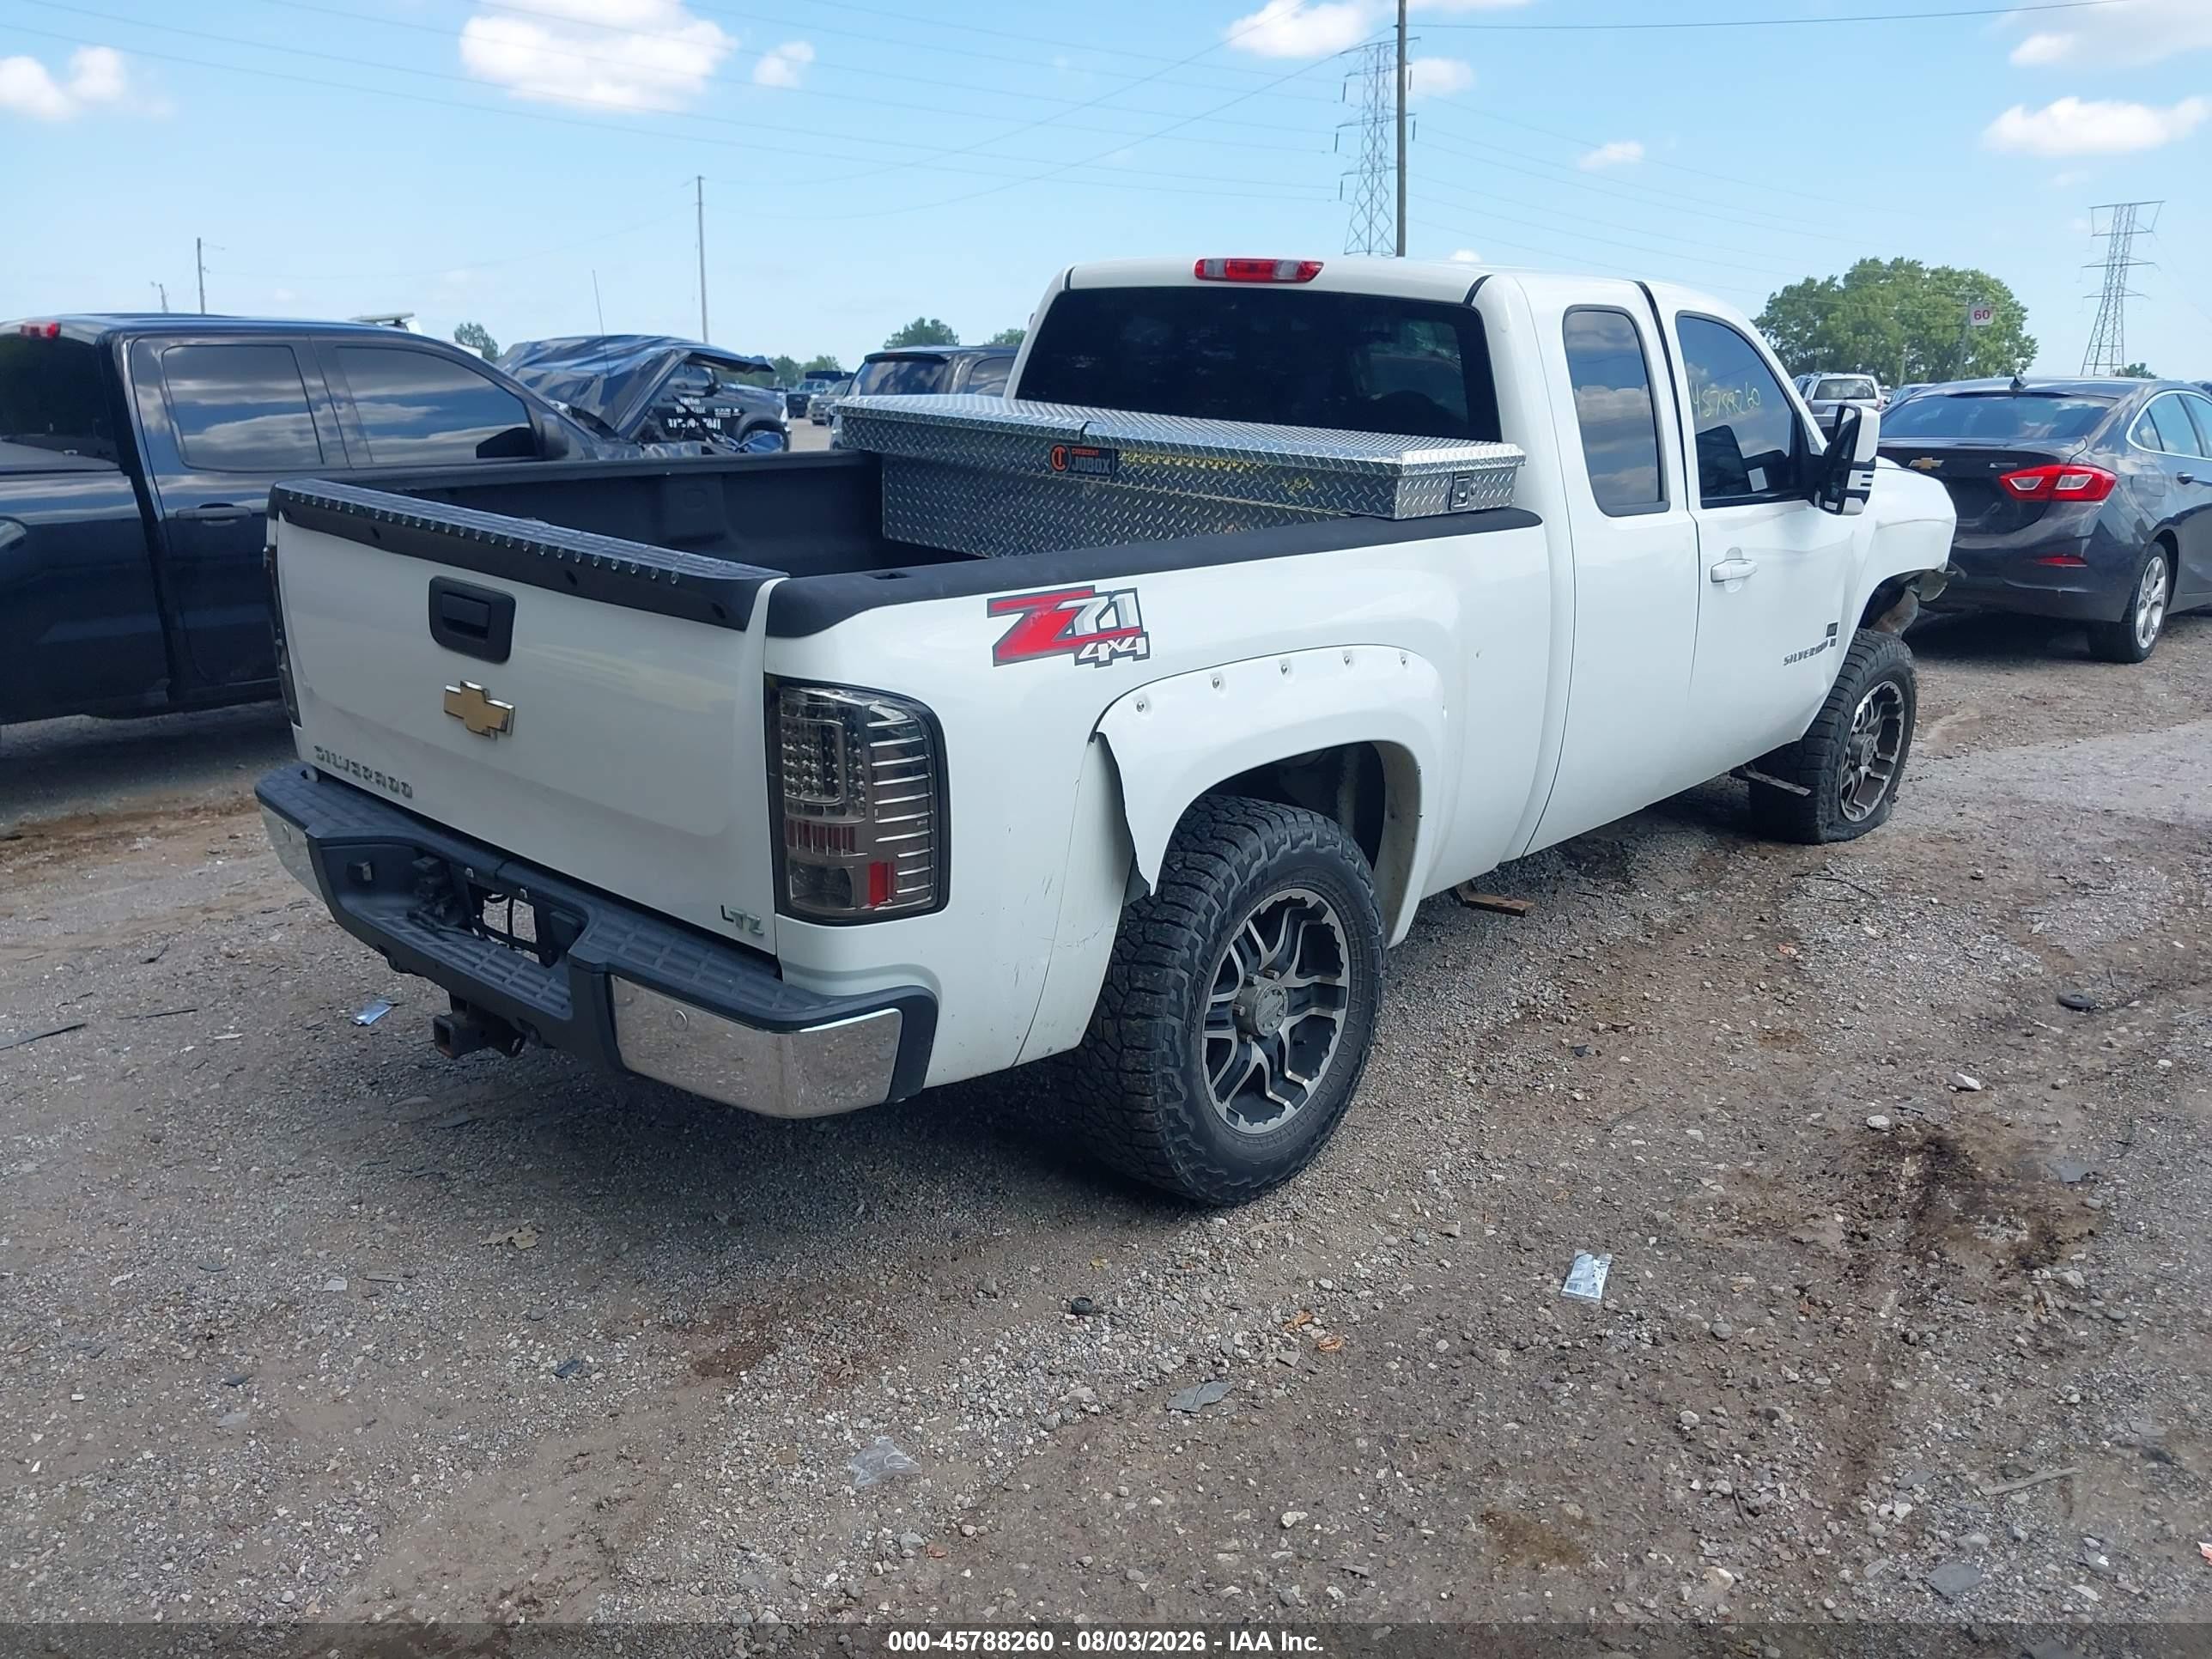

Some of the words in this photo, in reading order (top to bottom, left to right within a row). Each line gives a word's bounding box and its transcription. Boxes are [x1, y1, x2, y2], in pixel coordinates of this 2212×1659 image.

[1973, 309, 1990, 320] 60
[1071, 455, 1111, 475] JOBOX
[987, 586, 1143, 667] Z71
[313, 744, 413, 799] SILVERADO
[720, 904, 764, 936] LTZ
